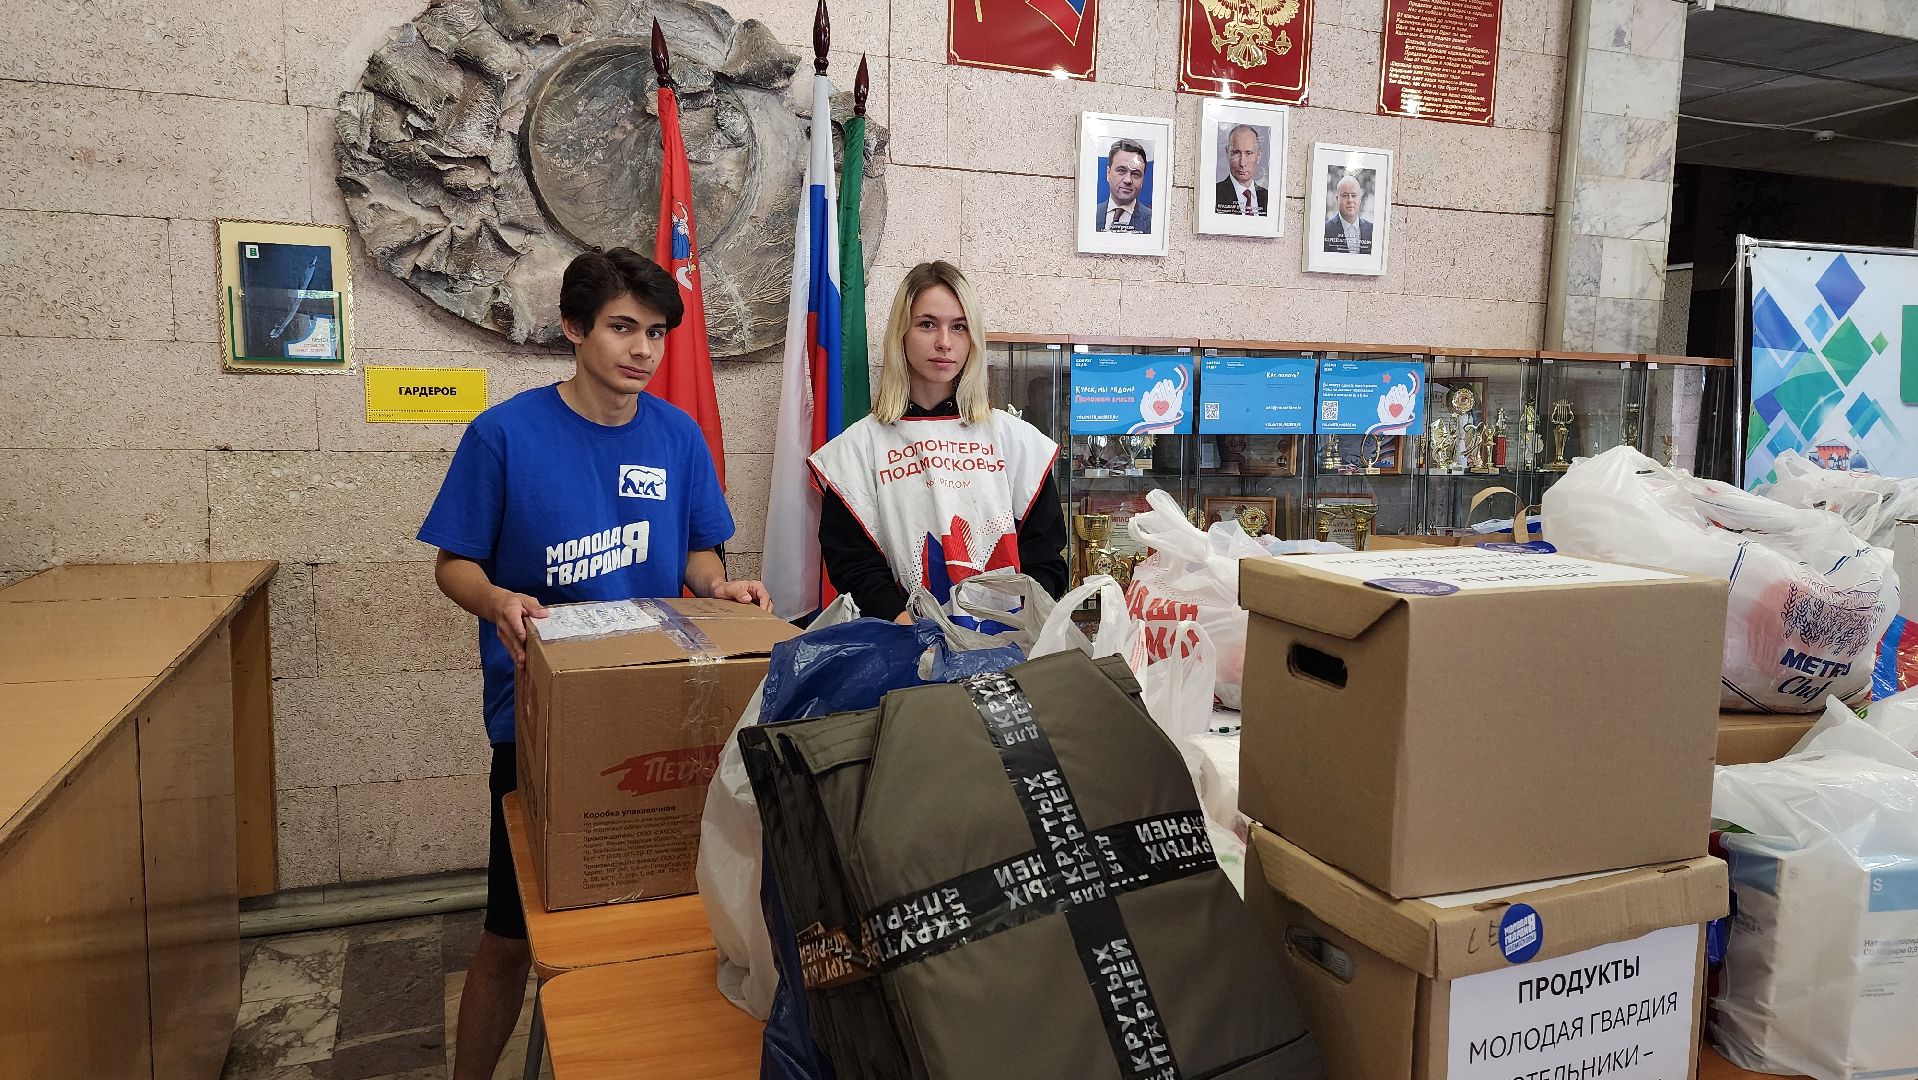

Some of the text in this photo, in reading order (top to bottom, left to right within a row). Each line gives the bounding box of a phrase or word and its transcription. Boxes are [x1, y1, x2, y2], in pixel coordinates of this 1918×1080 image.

[398, 386, 458, 398] ГАРДЕРОБ
[887, 439, 995, 465] ВОЛОНТЕРЫ
[879, 456, 1006, 486] ПОДМОСКОВЬЯ
[1777, 675, 1834, 705] Chef
[583, 805, 676, 820] Коробка упаковочная
[1022, 773, 1082, 886] КРУТЫХ
[1144, 835, 1214, 865] РУТЫХ
[1872, 877, 1883, 892] S
[1518, 955, 1641, 1004] ПРОДУКТЫ
[1091, 943, 1152, 1073] КРУТЫХ
[1469, 990, 1679, 1065] МОЛОДАЯ ГВАРДИЯ
